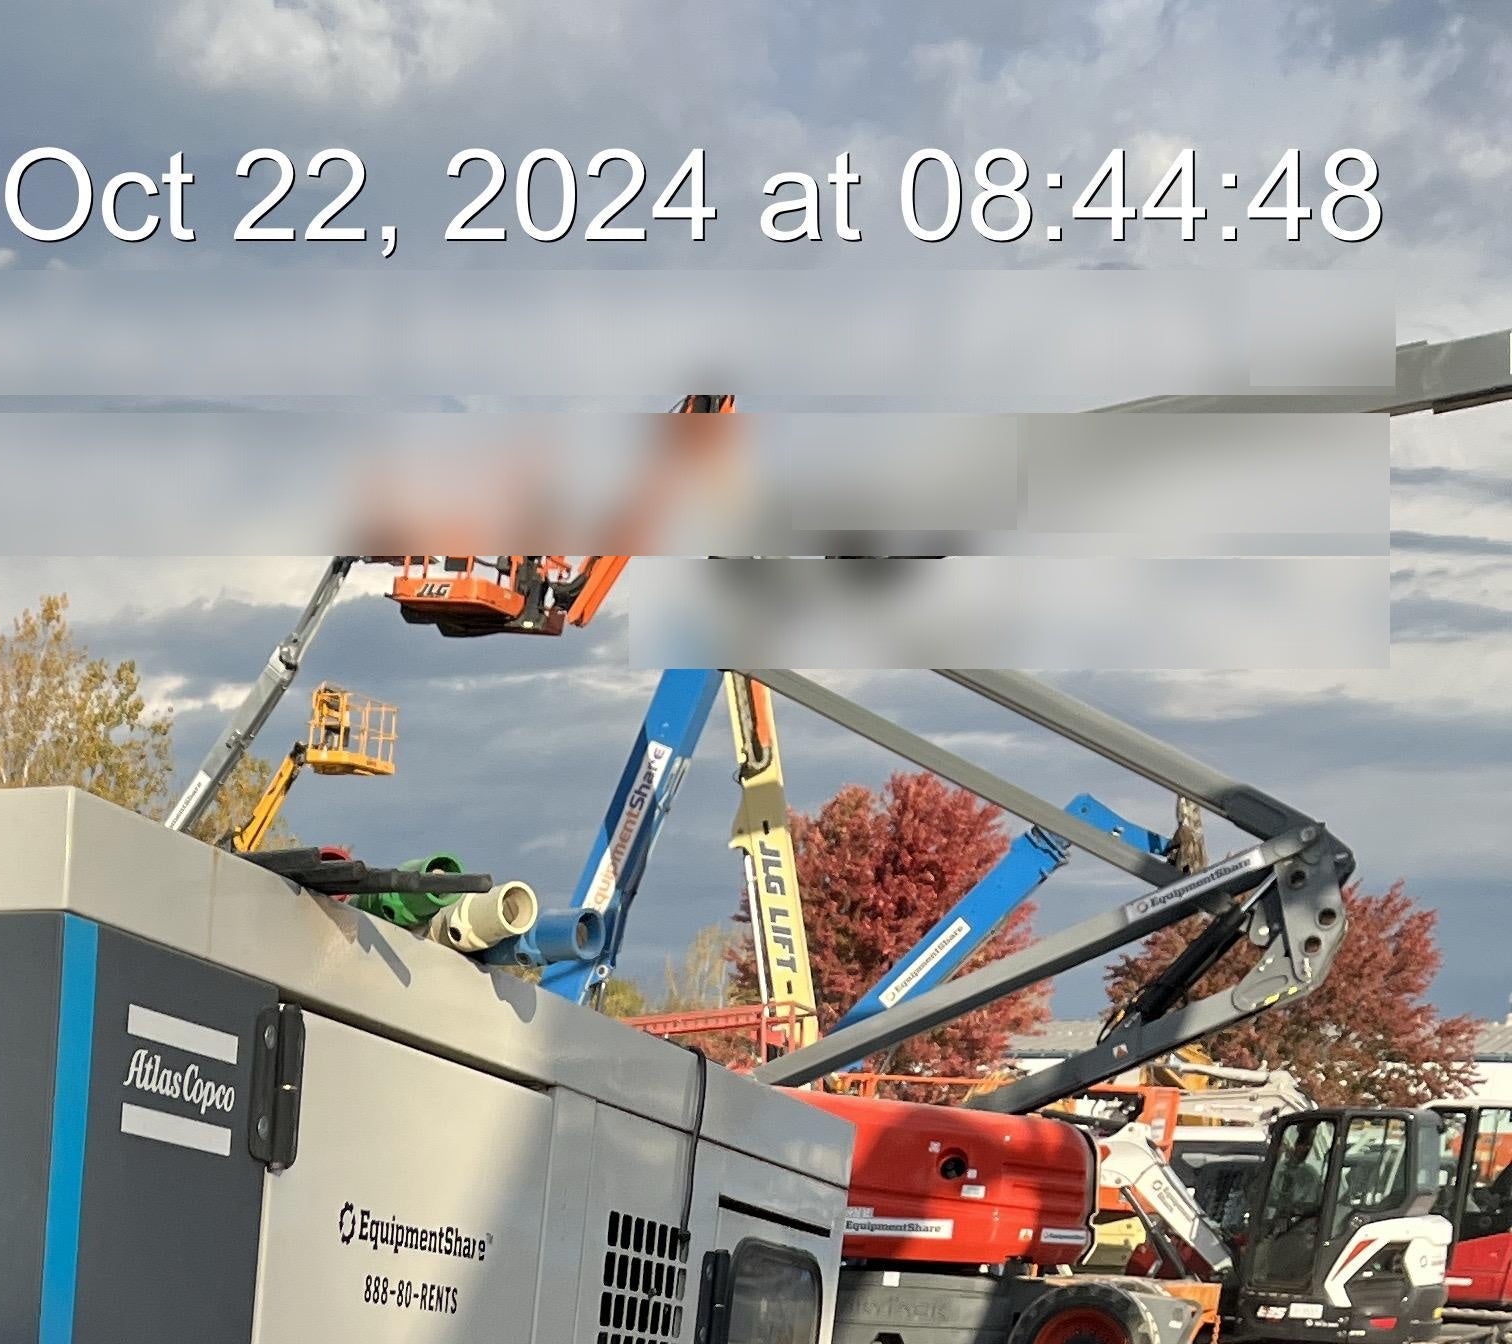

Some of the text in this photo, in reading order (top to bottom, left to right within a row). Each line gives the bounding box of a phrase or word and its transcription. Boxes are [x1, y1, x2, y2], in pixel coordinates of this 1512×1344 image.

[416, 583, 450, 597] JLG
[759, 840, 798, 973] JLG LIFT
[1150, 857, 1252, 908] EquipmentShare
[123, 1048, 235, 1115] Atlas Copco
[359, 1209, 486, 1261] EquipmentShare
[364, 1274, 458, 1314] 888-80-RENTS
